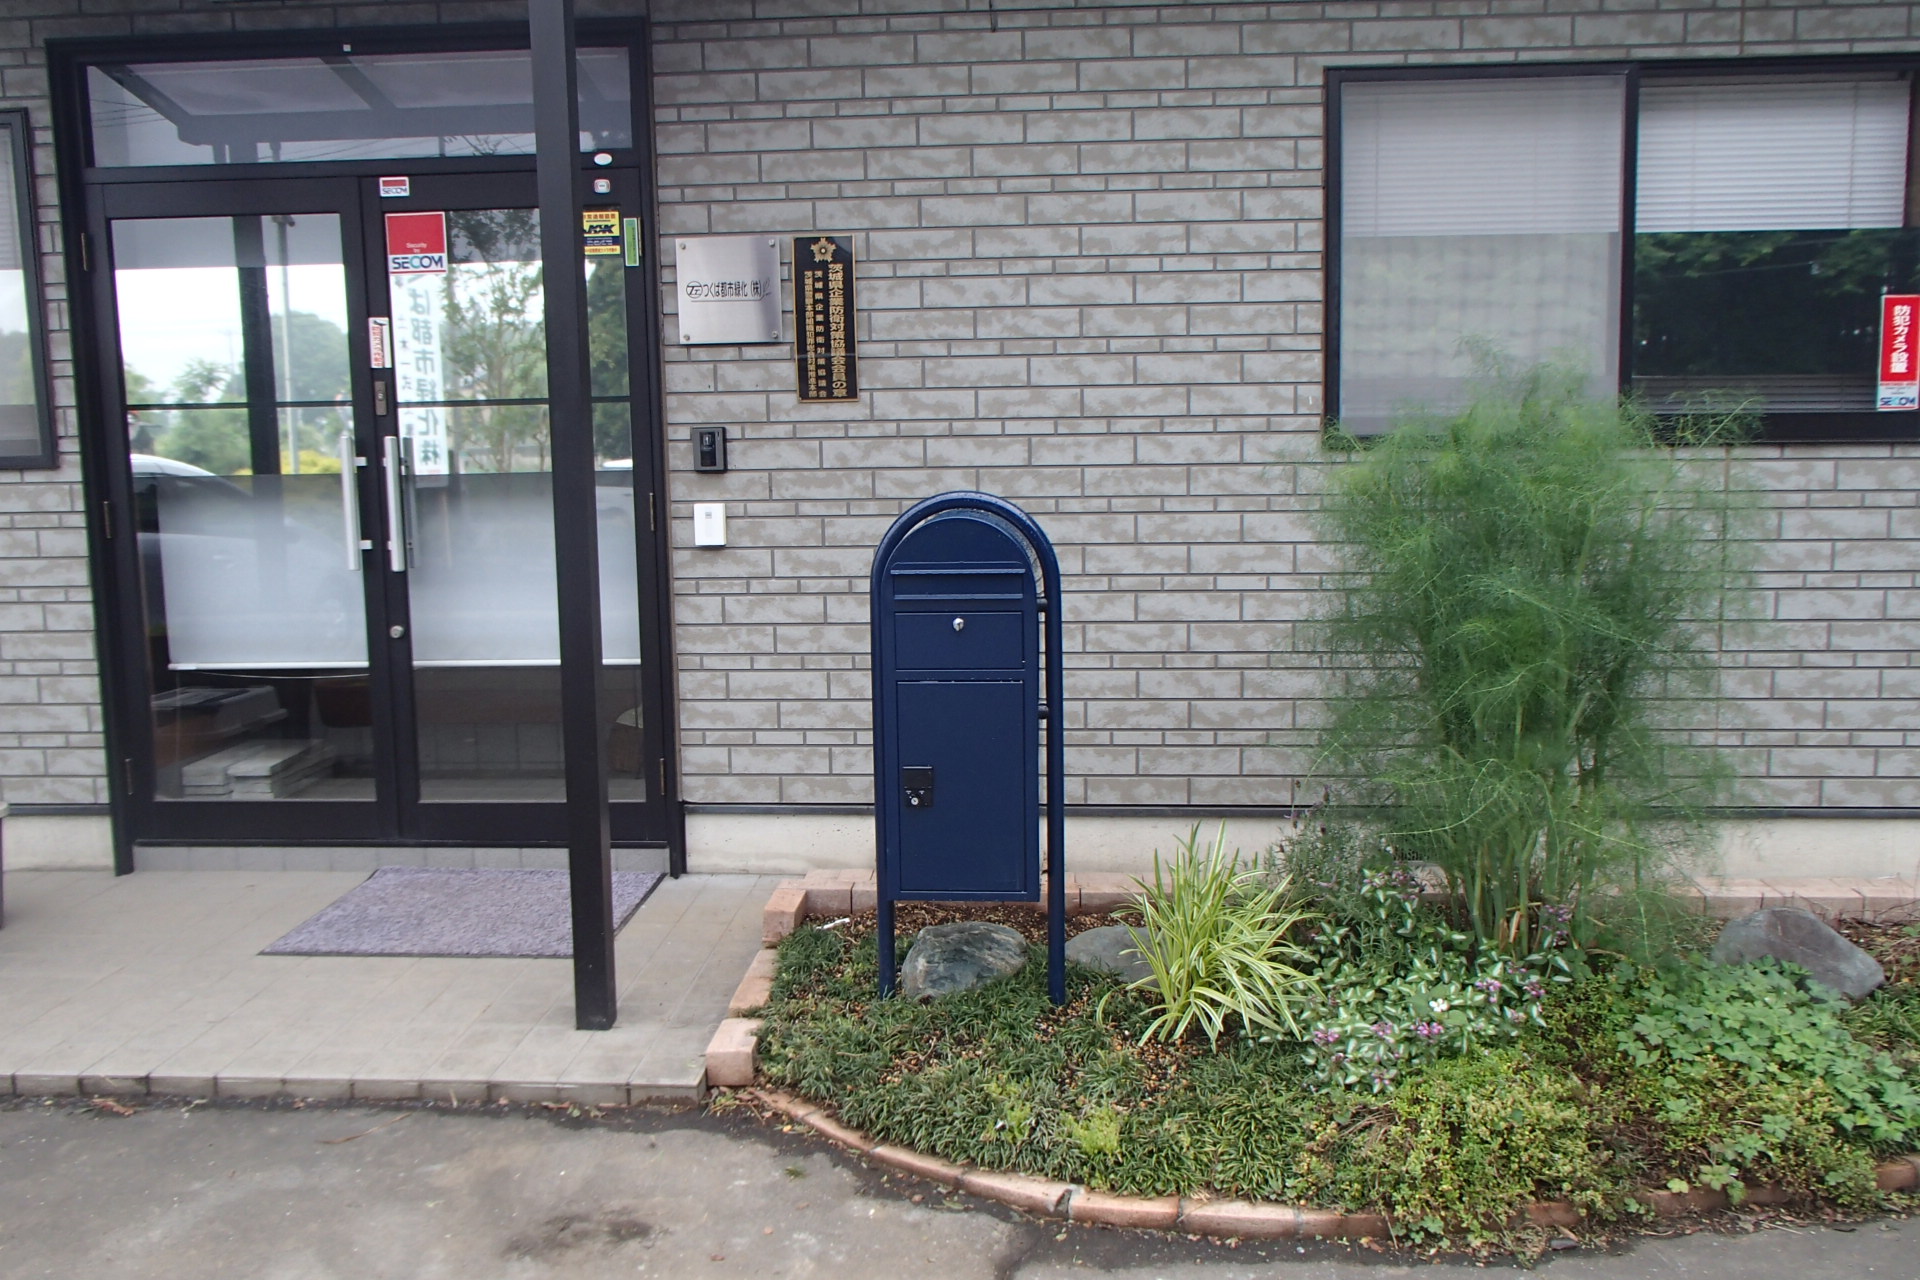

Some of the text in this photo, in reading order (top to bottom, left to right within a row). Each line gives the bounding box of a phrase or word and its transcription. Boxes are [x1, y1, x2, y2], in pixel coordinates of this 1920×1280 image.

[382, 187, 408, 195] SECOM
[392, 254, 443, 269] SECOM
[1890, 305, 1911, 373] 防犯カメラ設置
